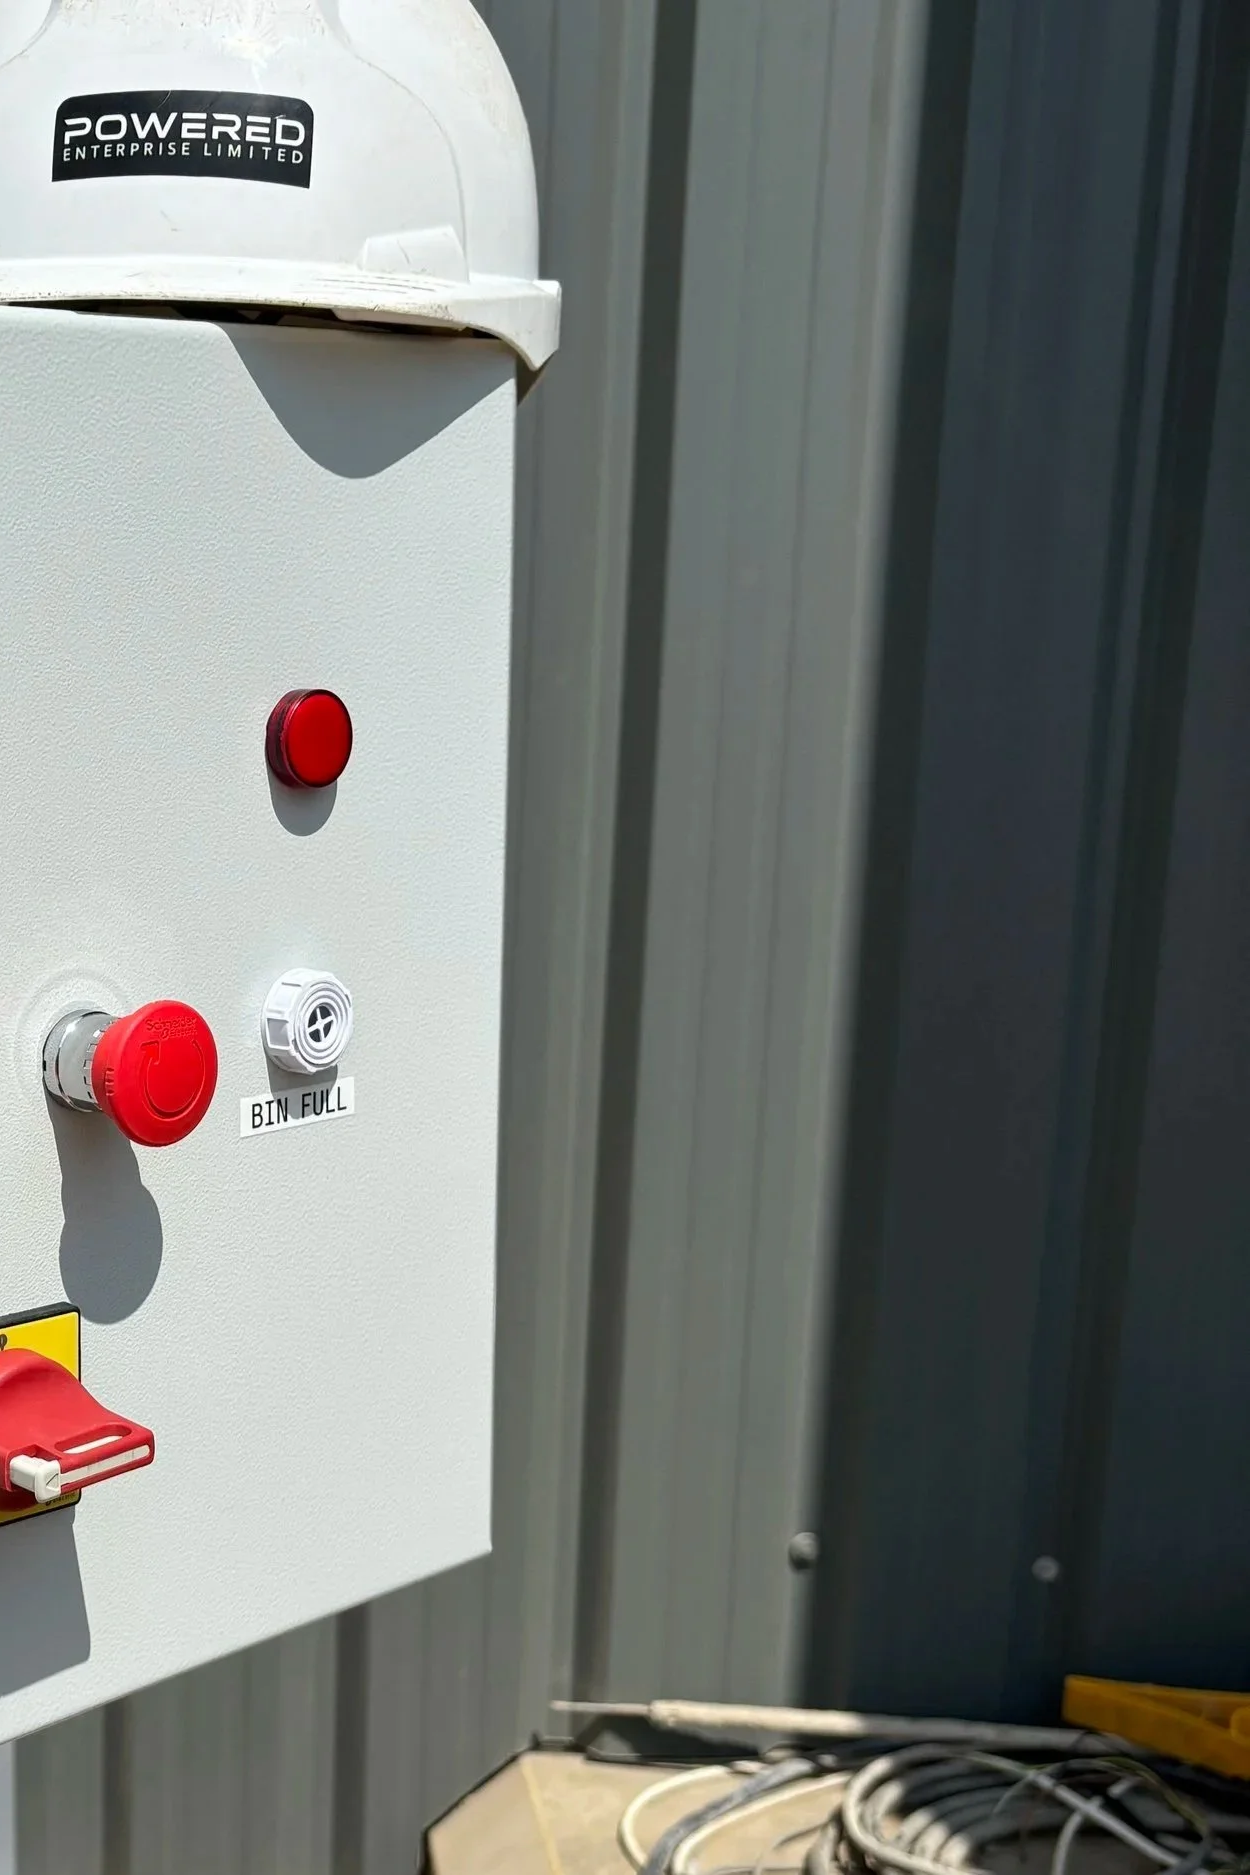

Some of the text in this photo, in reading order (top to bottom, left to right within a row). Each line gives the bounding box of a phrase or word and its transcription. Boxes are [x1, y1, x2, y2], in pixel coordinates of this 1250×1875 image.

[63, 112, 306, 147] POWERED
[63, 142, 304, 164] ENTERPRISE LIMITED
[252, 1086, 347, 1129] BIN FULL
